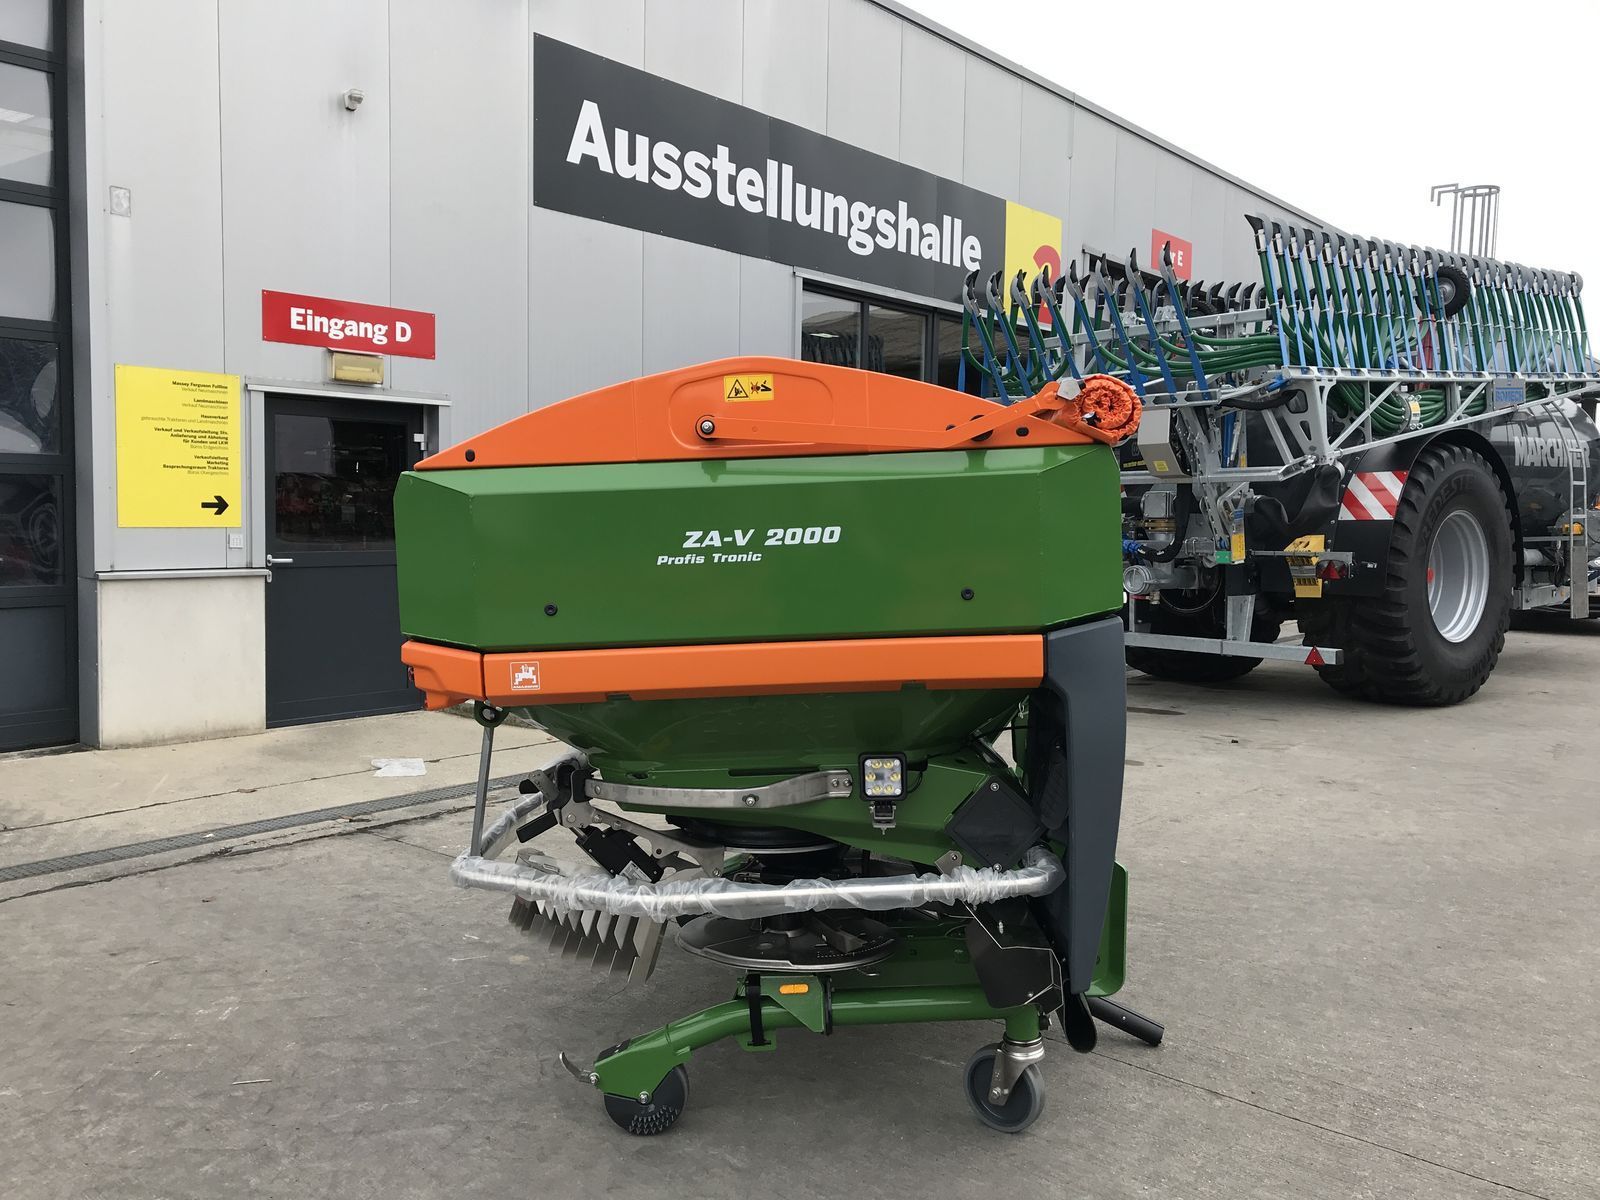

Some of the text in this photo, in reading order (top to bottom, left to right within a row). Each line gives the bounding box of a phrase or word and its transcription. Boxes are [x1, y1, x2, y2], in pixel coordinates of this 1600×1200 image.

[566, 99, 982, 272] Ausstellungshalle
[290, 306, 412, 346] Eingang D
[682, 526, 842, 548] ZA-V 2000
[656, 551, 762, 566] Profis Tronic
